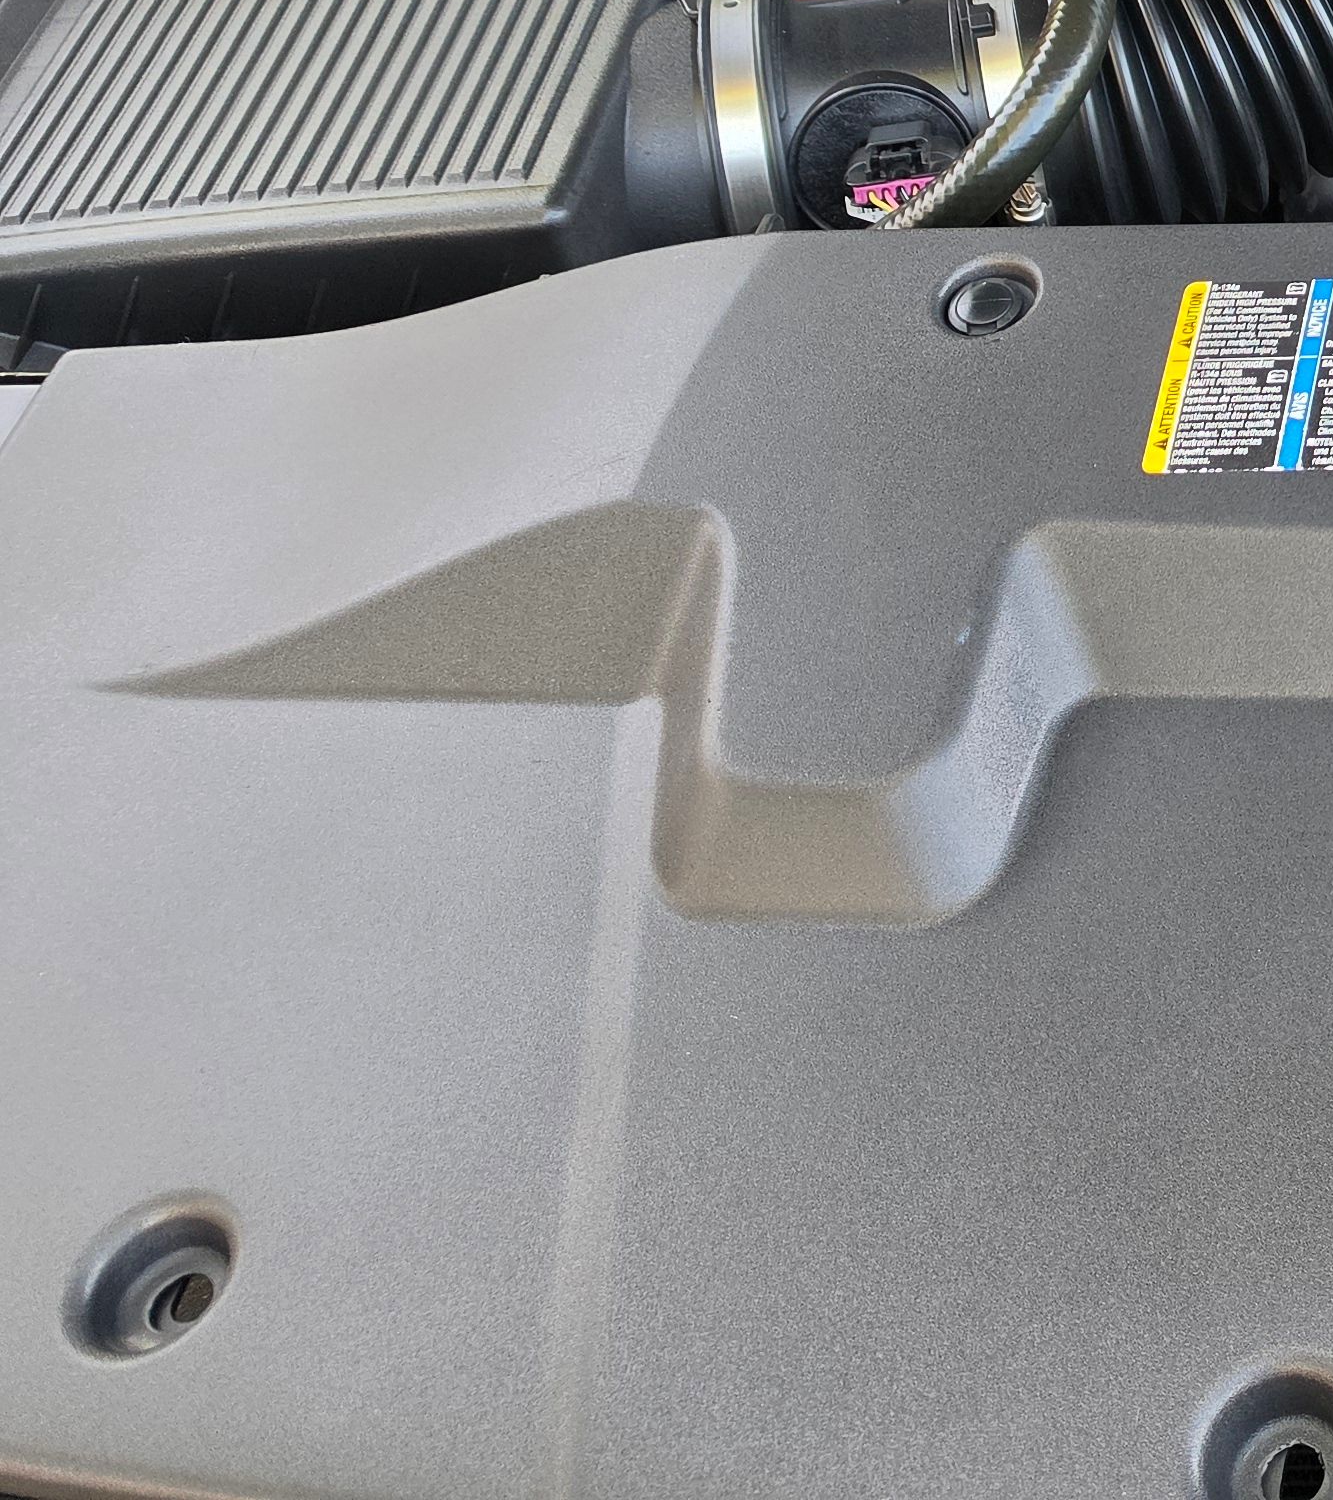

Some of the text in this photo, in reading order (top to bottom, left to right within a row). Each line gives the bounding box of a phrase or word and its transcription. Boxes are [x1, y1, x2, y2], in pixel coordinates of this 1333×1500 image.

[1184, 292, 1203, 335] CAUTION
[1306, 299, 1328, 337] NOTICE
[1159, 378, 1182, 435] ATTENTION
[1289, 392, 1309, 420] AVIS
